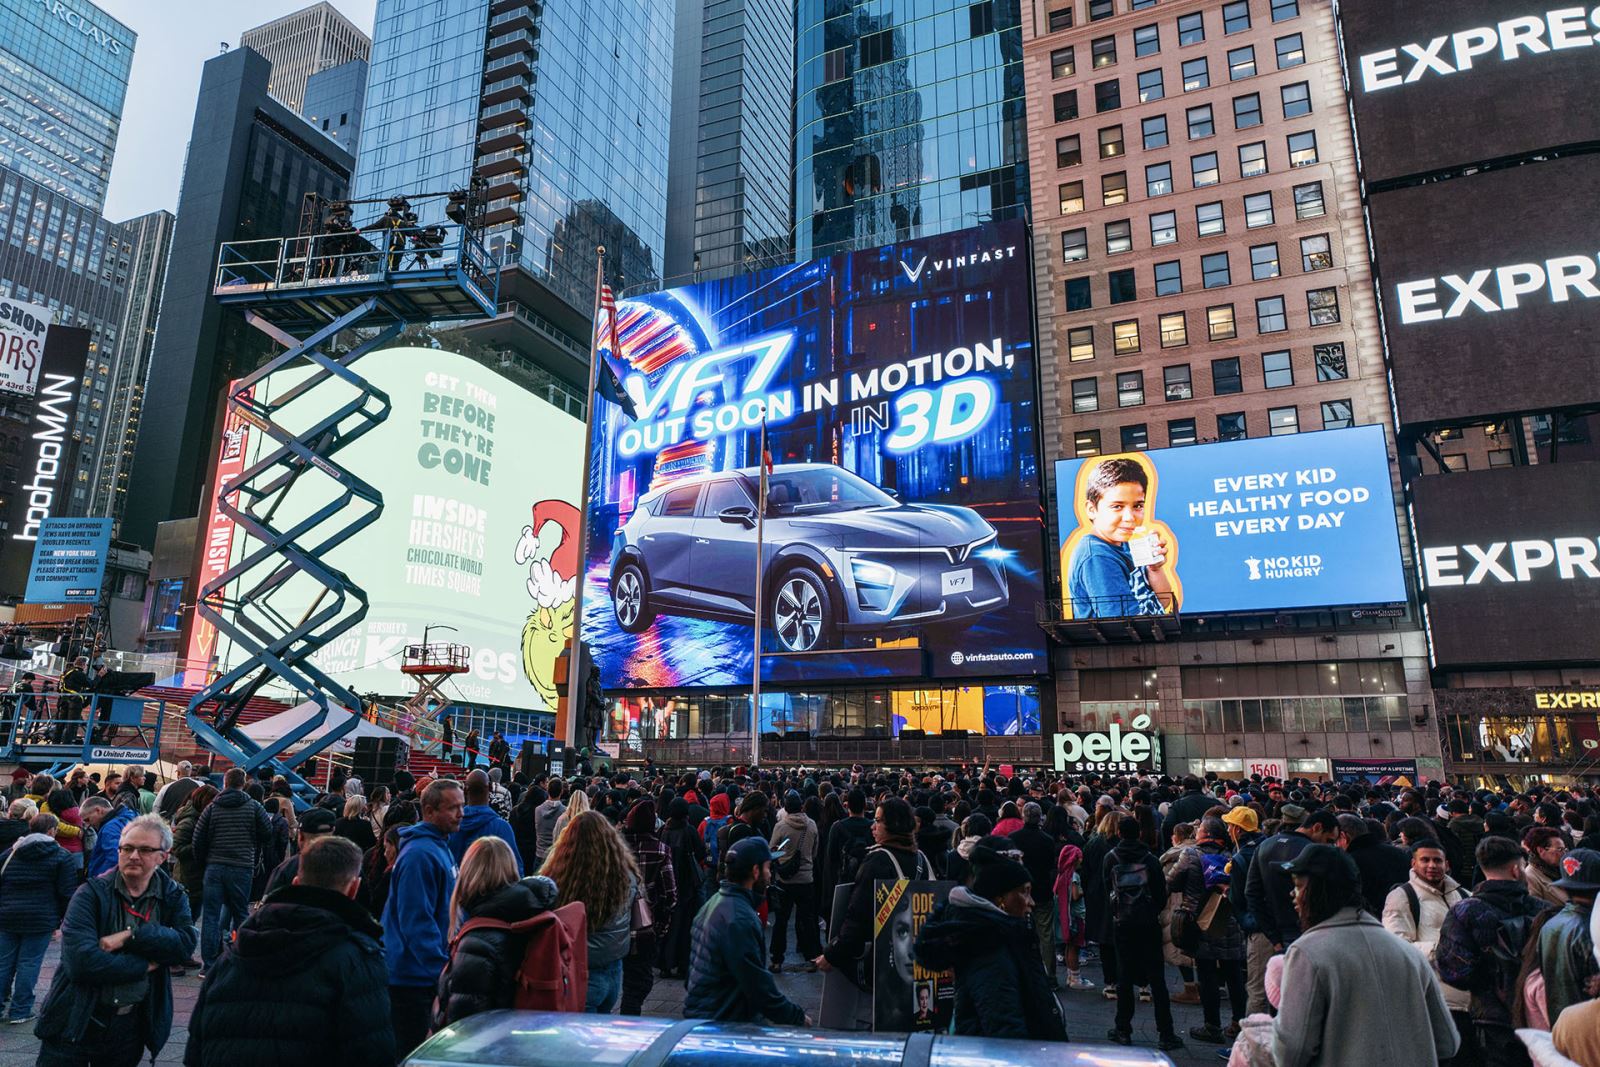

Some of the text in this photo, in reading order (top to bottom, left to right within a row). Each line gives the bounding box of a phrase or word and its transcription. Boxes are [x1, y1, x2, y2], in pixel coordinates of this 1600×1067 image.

[1360, 6, 1600, 93] EXPRE
[934, 247, 1015, 271] VINFAST
[1397, 252, 1600, 324] EXPR
[0, 302, 46, 337] SHOP
[425, 372, 497, 409] GET THEM
[620, 338, 1015, 455] OUT SOON IN MOTION,
[424, 392, 495, 433] BEFORE
[852, 380, 991, 449] IN 3D
[421, 420, 494, 457] THEY'RE
[418, 443, 492, 486] GONE
[1214, 468, 1337, 493] EVERY KID
[413, 494, 487, 533] INSIDE
[1189, 487, 1369, 517] HEALTHY FOOD
[409, 520, 485, 559] HERSHEY'S
[1215, 512, 1345, 537] EVERY DAY
[407, 548, 483, 576] CHOCOLATE WORLD
[1264, 555, 1322, 570] NO KID
[1265, 567, 1322, 579] HUNGRY
[1423, 536, 1600, 587] EXPR
[406, 565, 481, 597] TIMES SQUARE
[950, 577, 966, 587] VF7
[966, 653, 1034, 662] vinfastauto.com
[1536, 692, 1600, 709] EXPR
[1076, 762, 1138, 772] SOCCER
[1251, 764, 1278, 777] 1560
[876, 883, 890, 904] #1
[878, 883, 903, 925] NEW PLAY
[912, 892, 935, 914] ODE
